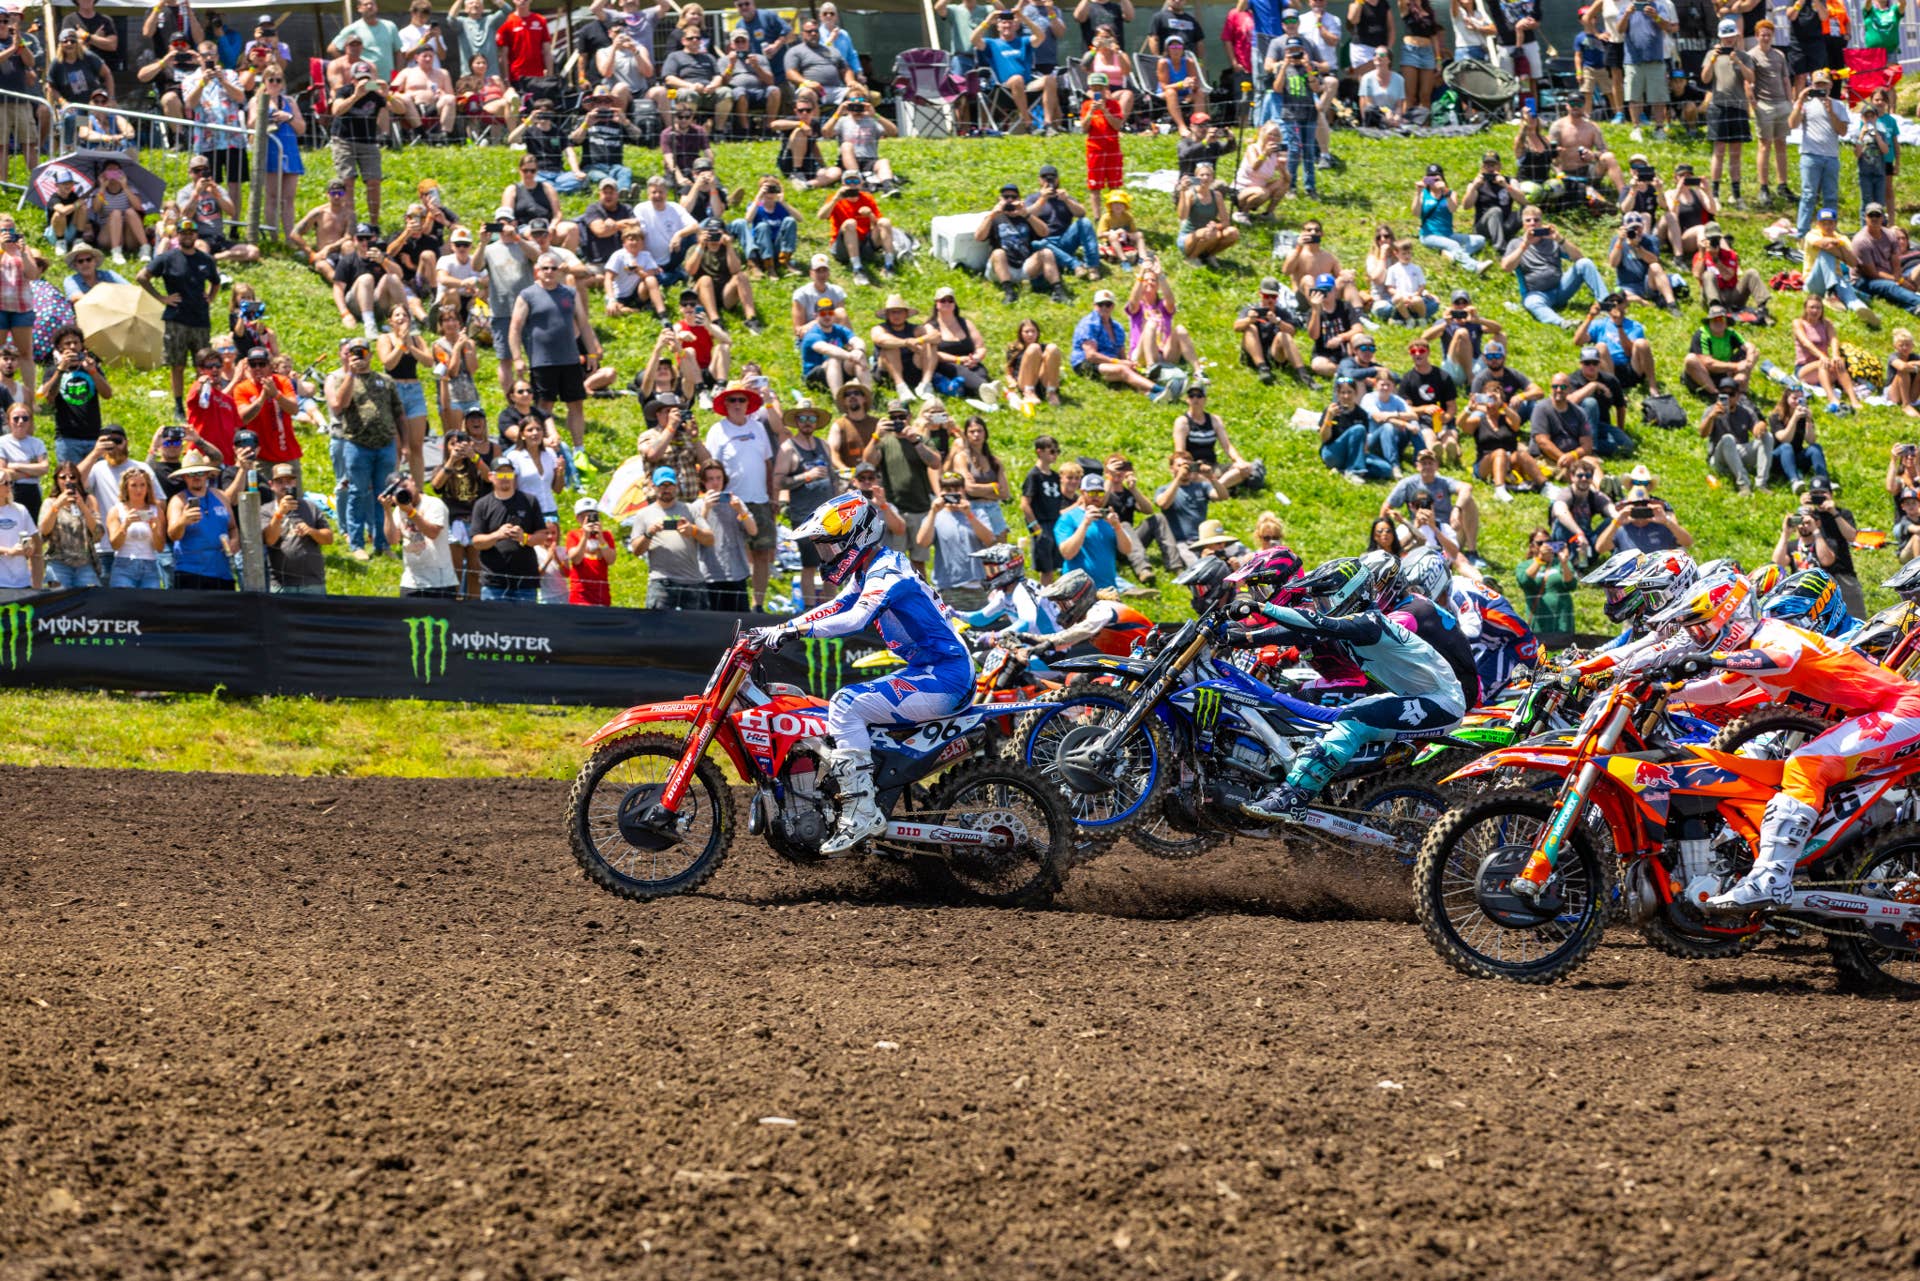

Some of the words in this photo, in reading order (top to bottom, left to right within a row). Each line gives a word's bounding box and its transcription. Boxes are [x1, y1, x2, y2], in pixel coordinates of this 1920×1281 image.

[1718, 594, 1739, 620] FOX
[1808, 577, 1837, 621] 100%
[38, 615, 142, 635] MONSTER
[53, 637, 126, 646] ENERGY
[452, 630, 552, 653] MONSTER
[466, 652, 536, 662] ENERGY
[649, 703, 699, 713] PROGRESSIVE
[921, 720, 963, 747] 96
[667, 752, 693, 801] DUNLOP
[1553, 798, 1579, 837] MOTOREX
[896, 826, 921, 837] DID
[1881, 906, 1901, 916] DID
